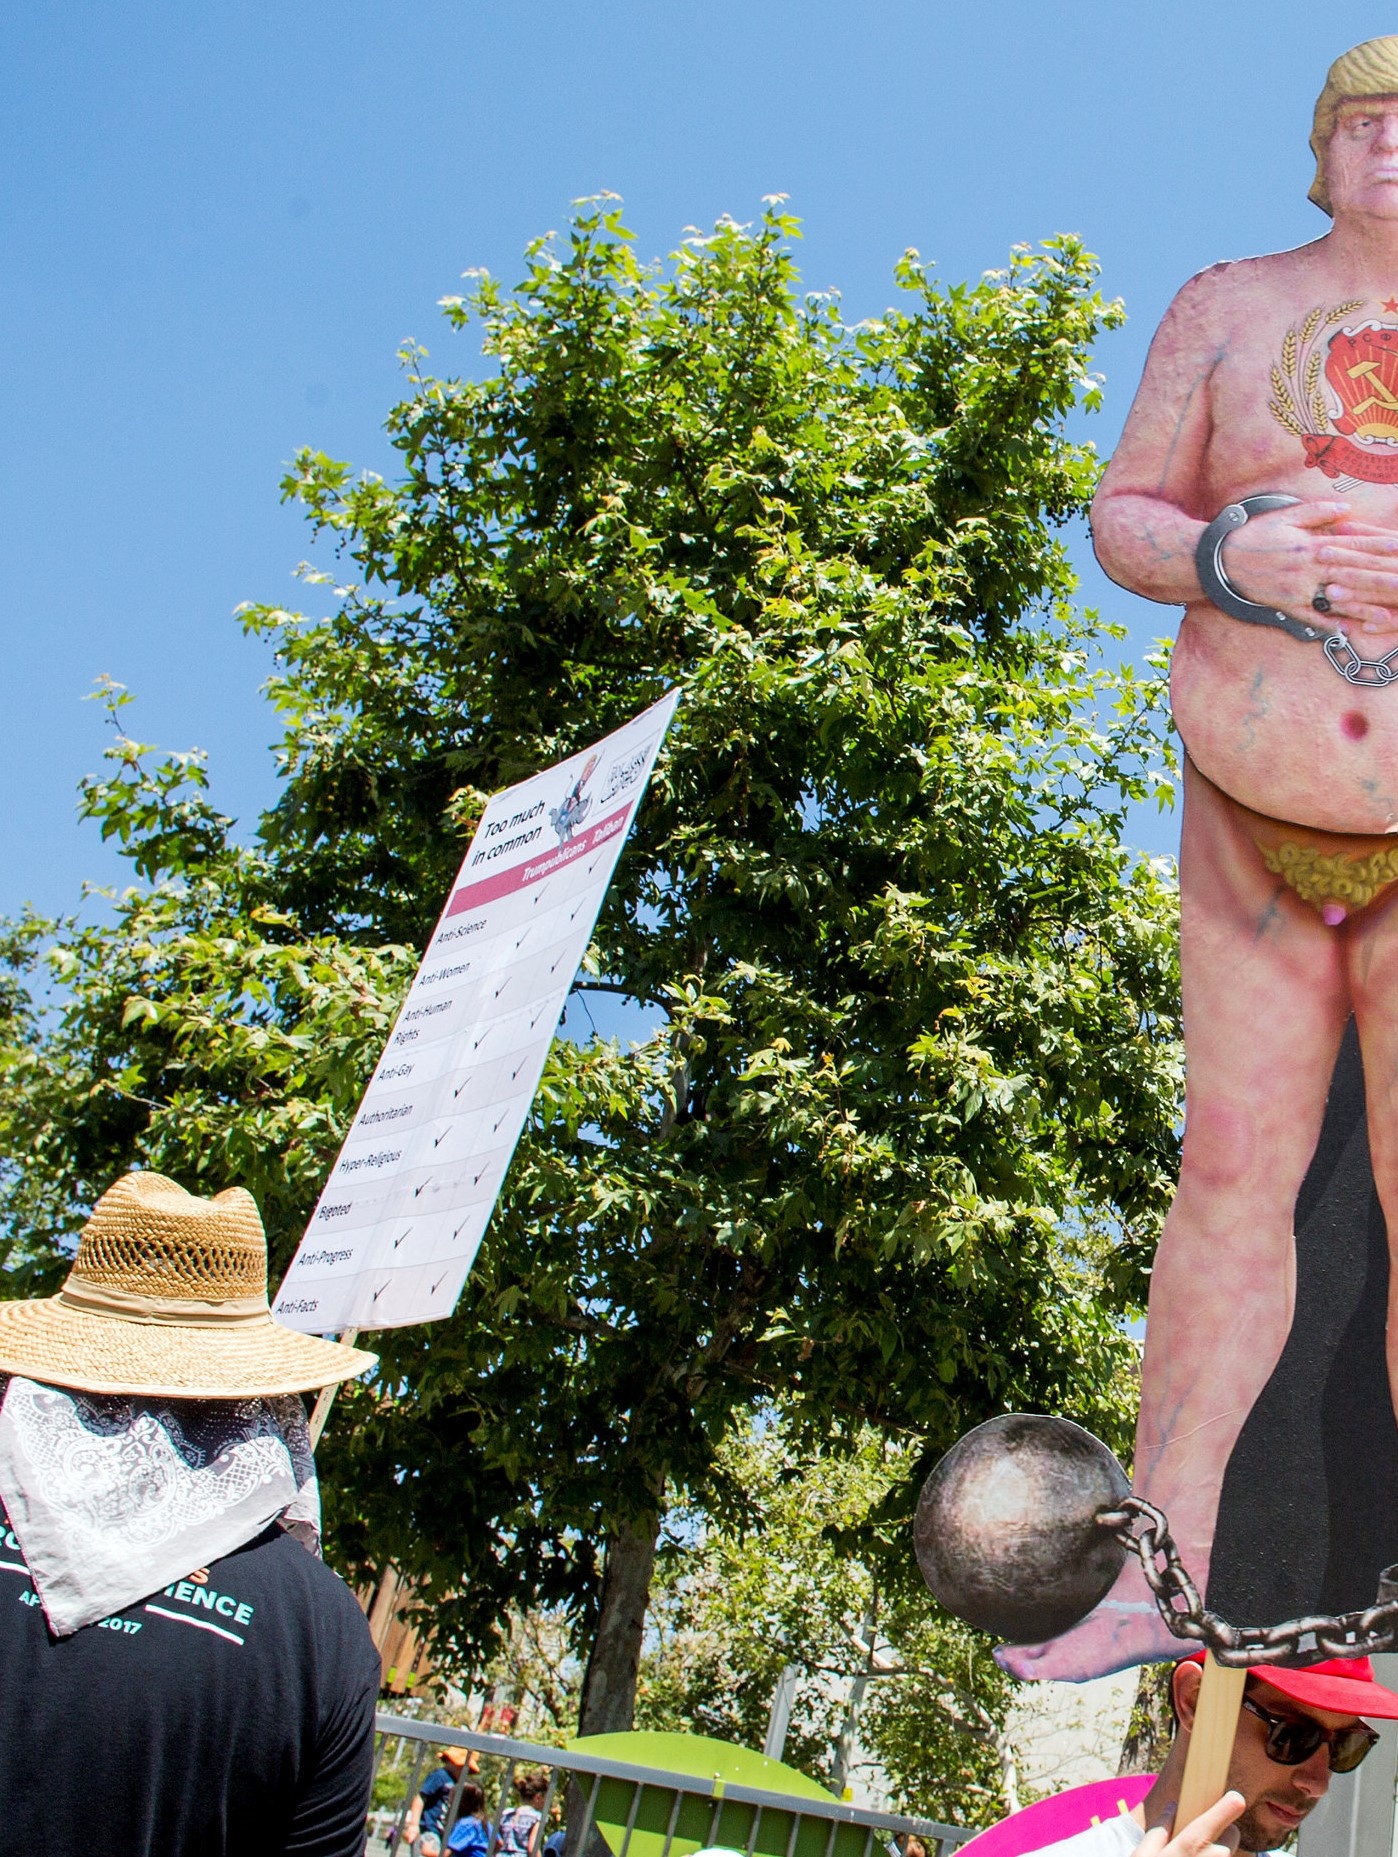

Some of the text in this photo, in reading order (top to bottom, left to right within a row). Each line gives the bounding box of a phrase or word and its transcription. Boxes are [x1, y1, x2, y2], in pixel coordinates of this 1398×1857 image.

[485, 800, 545, 839] Too much
[472, 826, 542, 867] in common
[522, 816, 624, 882] Trumpublicans Taliban
[436, 919, 487, 945] Anti-Science
[418, 962, 471, 987] Anti-Women
[403, 1000, 453, 1023] Anti-Human
[394, 1029, 420, 1046] Rights
[377, 1063, 415, 1081] Anti-Gay
[358, 1104, 413, 1126] Authoritarian
[338, 1150, 402, 1175] Hyper-Religious
[296, 1248, 354, 1266] Anti-Progress
[275, 1299, 319, 1314] Anti-Facts
[163, 1581, 254, 1626] IENCE
[97, 1616, 143, 1636] 2017
